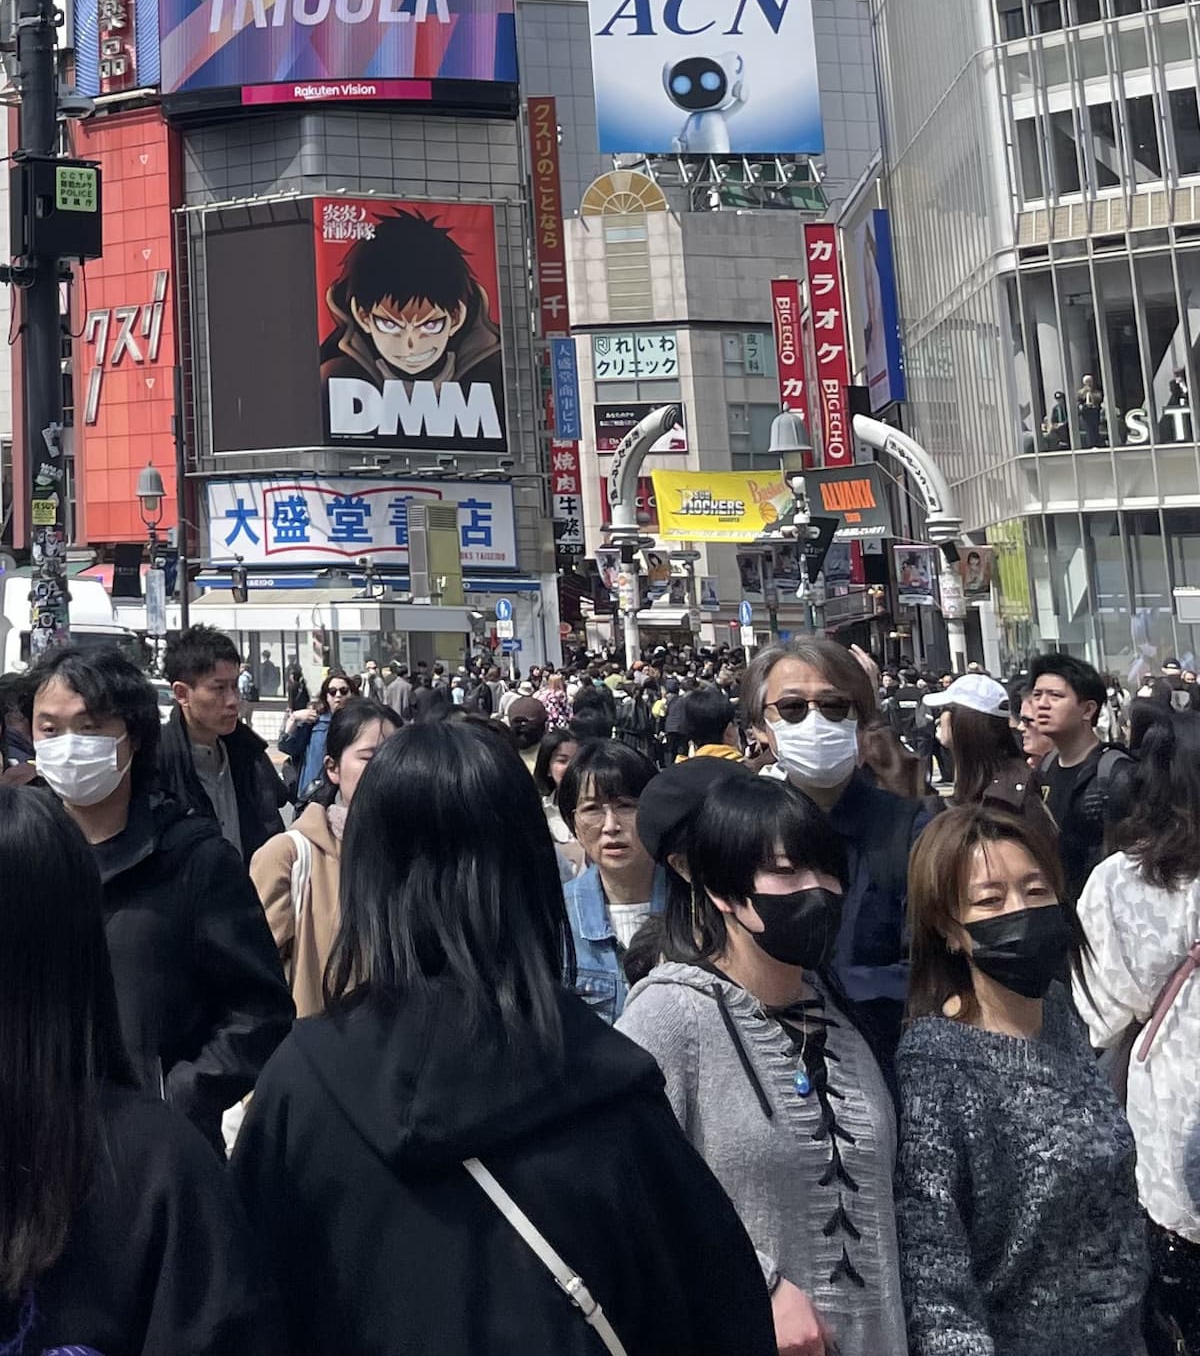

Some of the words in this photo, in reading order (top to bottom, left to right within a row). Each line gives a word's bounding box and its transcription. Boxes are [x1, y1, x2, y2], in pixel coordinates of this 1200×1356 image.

[294, 85, 338, 98] Rakuten
[340, 83, 376, 96] Vision
[61, 171, 93, 180] CCTV
[535, 104, 558, 249] クスリのことなら
[60, 188, 92, 198] POLICE
[775, 296, 791, 323] BIG
[809, 240, 843, 364] カラオケ
[83, 269, 169, 424] クスリ
[615, 335, 675, 355] れいわ
[780, 324, 796, 366] ECHO
[597, 357, 677, 376] クリニック
[329, 377, 503, 439] DMM
[821, 379, 841, 410] BIG
[828, 411, 845, 459] ECHO
[33, 501, 56, 511] JESUS
[680, 490, 745, 516] ROCKERS
